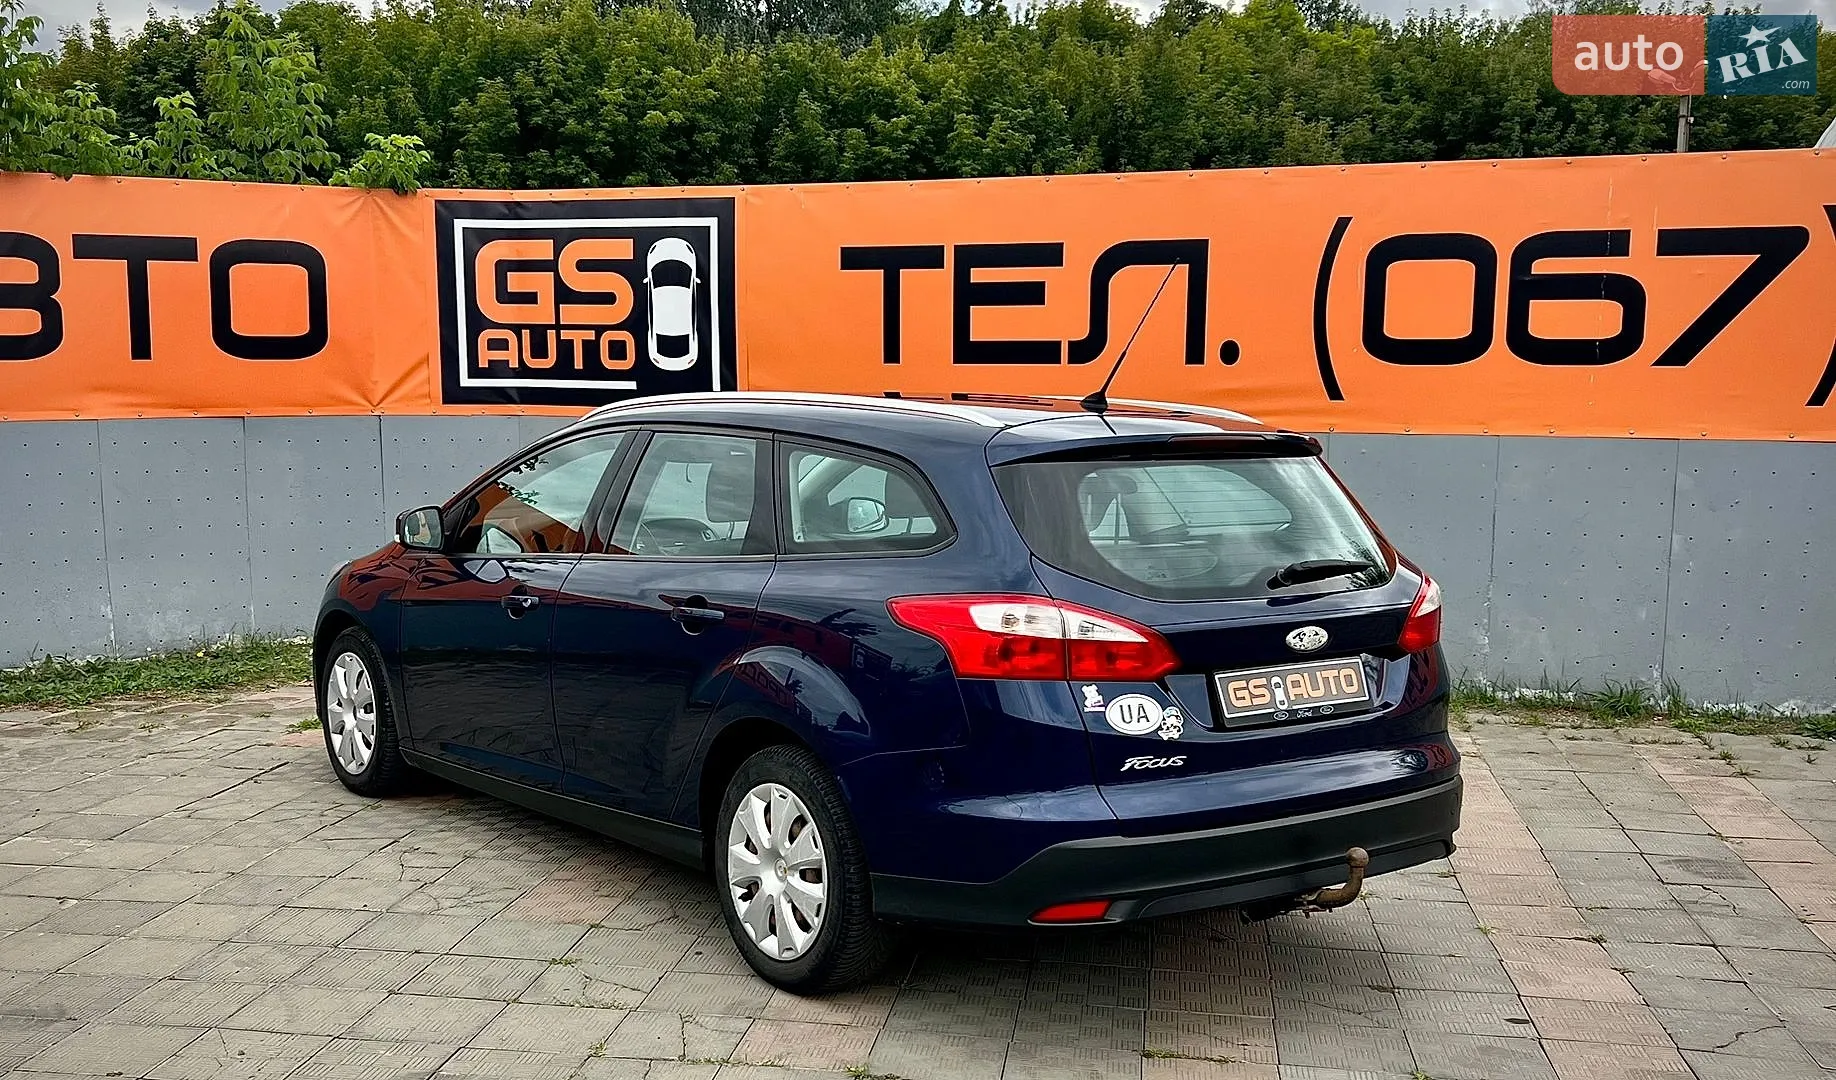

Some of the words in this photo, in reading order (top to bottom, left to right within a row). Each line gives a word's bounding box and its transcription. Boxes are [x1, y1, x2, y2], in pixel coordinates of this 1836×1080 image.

[475, 238, 635, 324] GS
[839, 238, 1241, 367] ТЕЛ.
[478, 329, 636, 370] AUTO
[1227, 678, 1271, 708] GS
[1285, 668, 1359, 701] AUTO
[1119, 704, 1150, 724] UA
